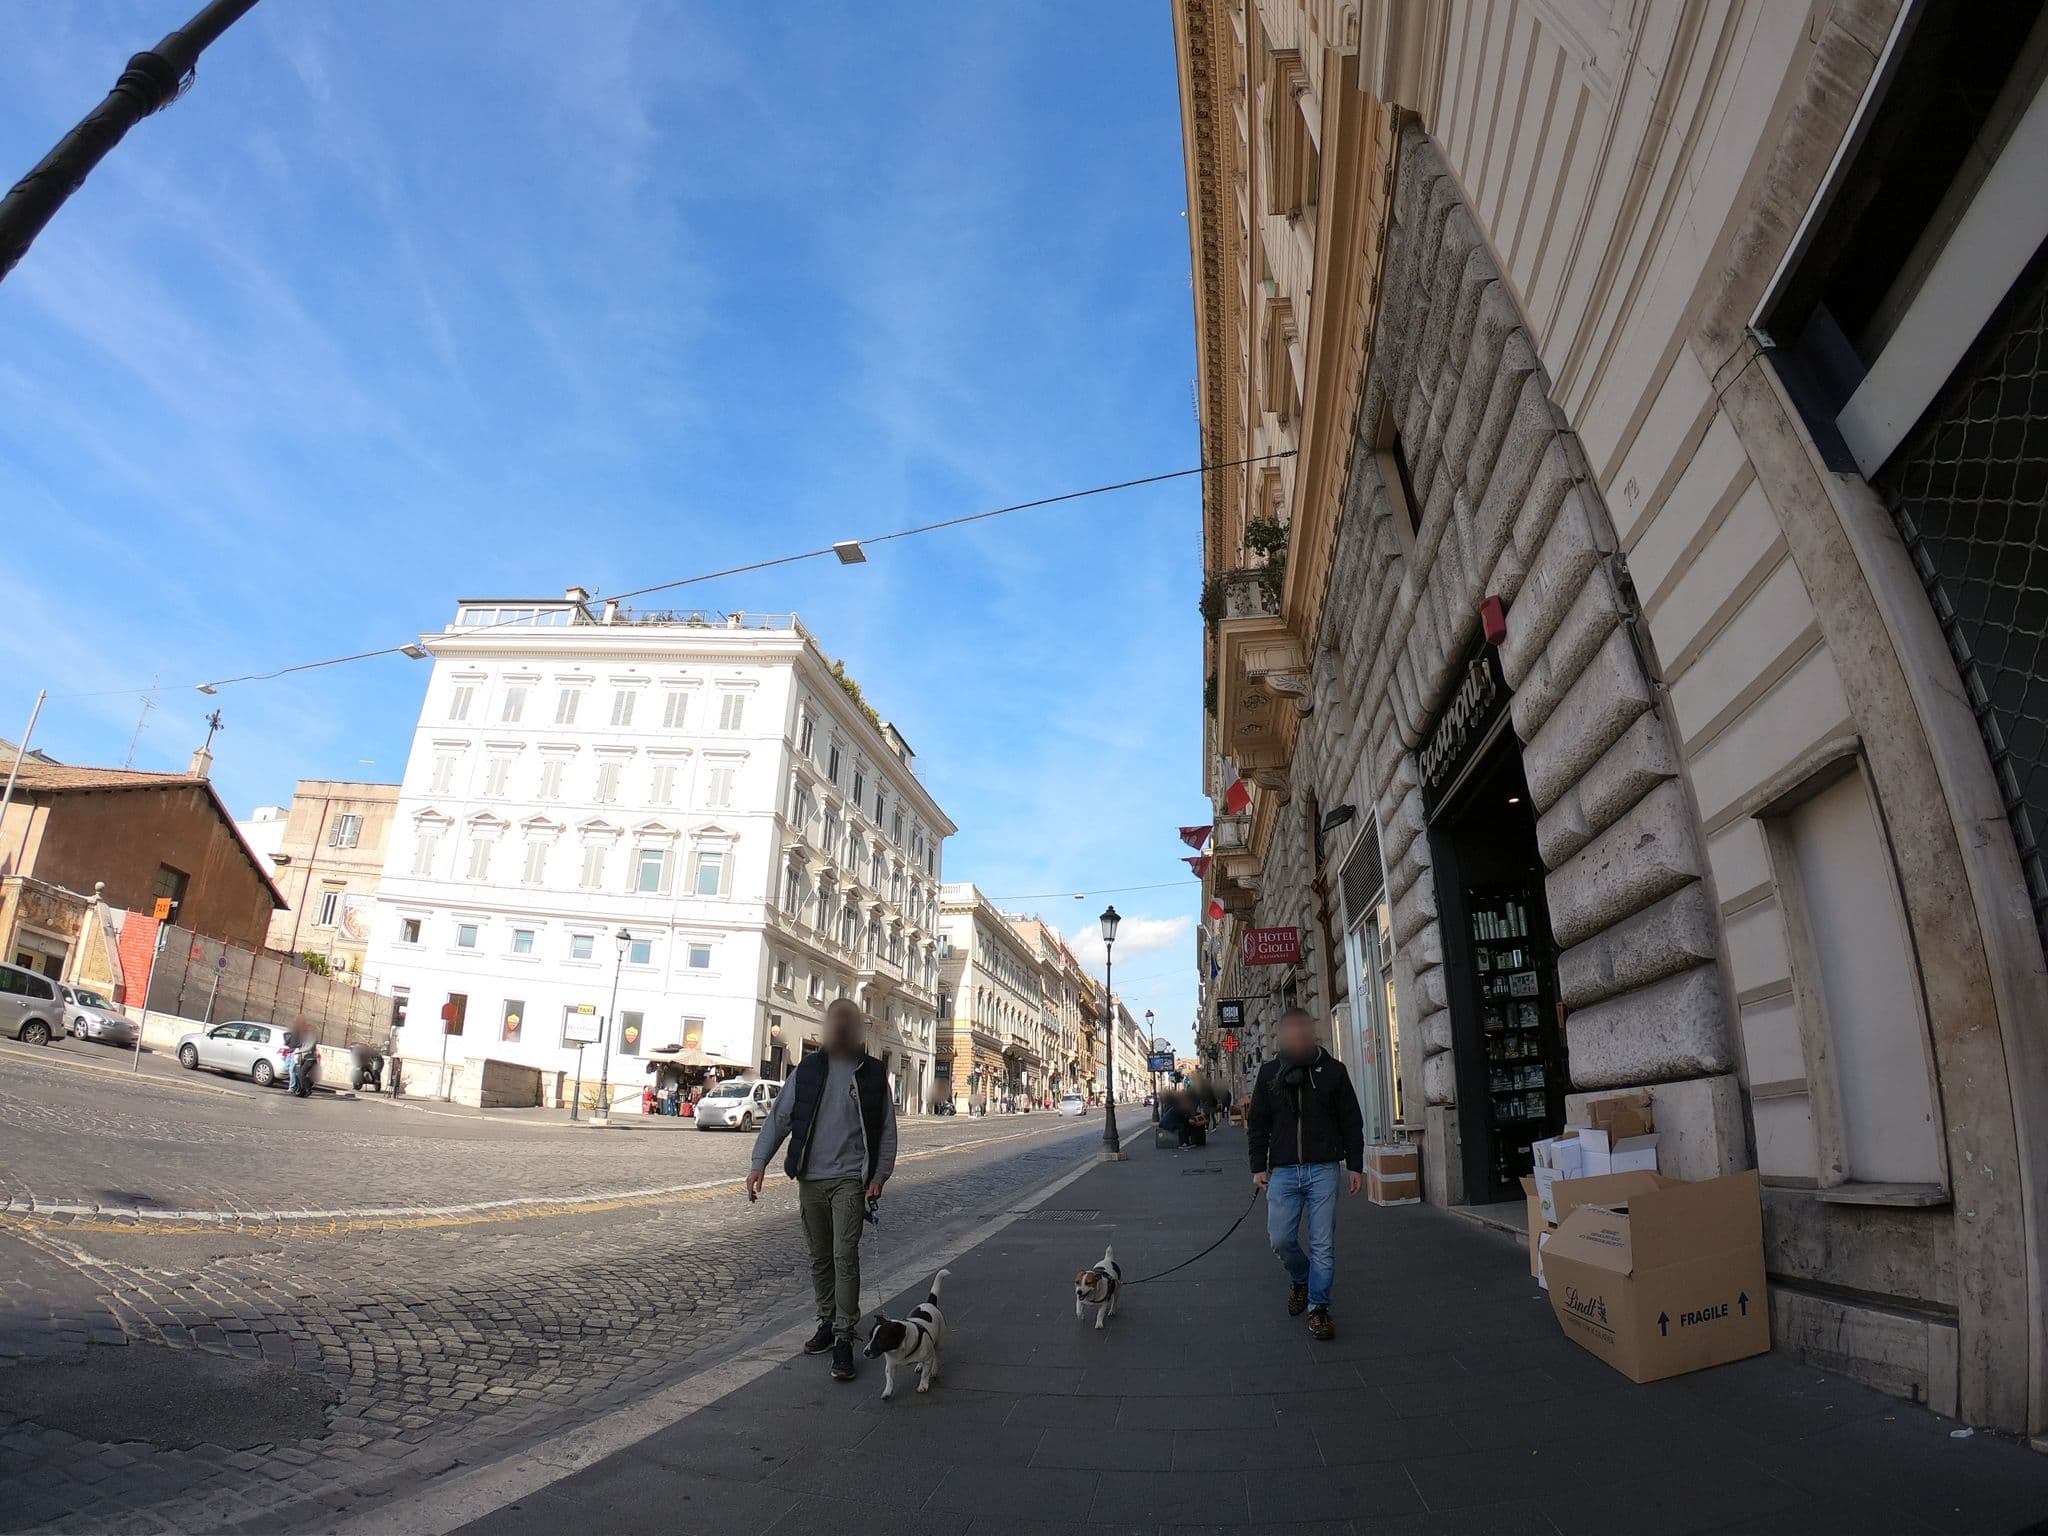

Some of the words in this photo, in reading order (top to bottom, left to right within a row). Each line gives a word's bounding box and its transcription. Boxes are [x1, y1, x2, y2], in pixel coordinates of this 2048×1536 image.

[1258, 931, 1295, 942] HOTEL
[1258, 943, 1295, 953] GIOLLI
[1565, 1287, 1596, 1316] Lindt
[1680, 1304, 1728, 1327] FRAGILE
